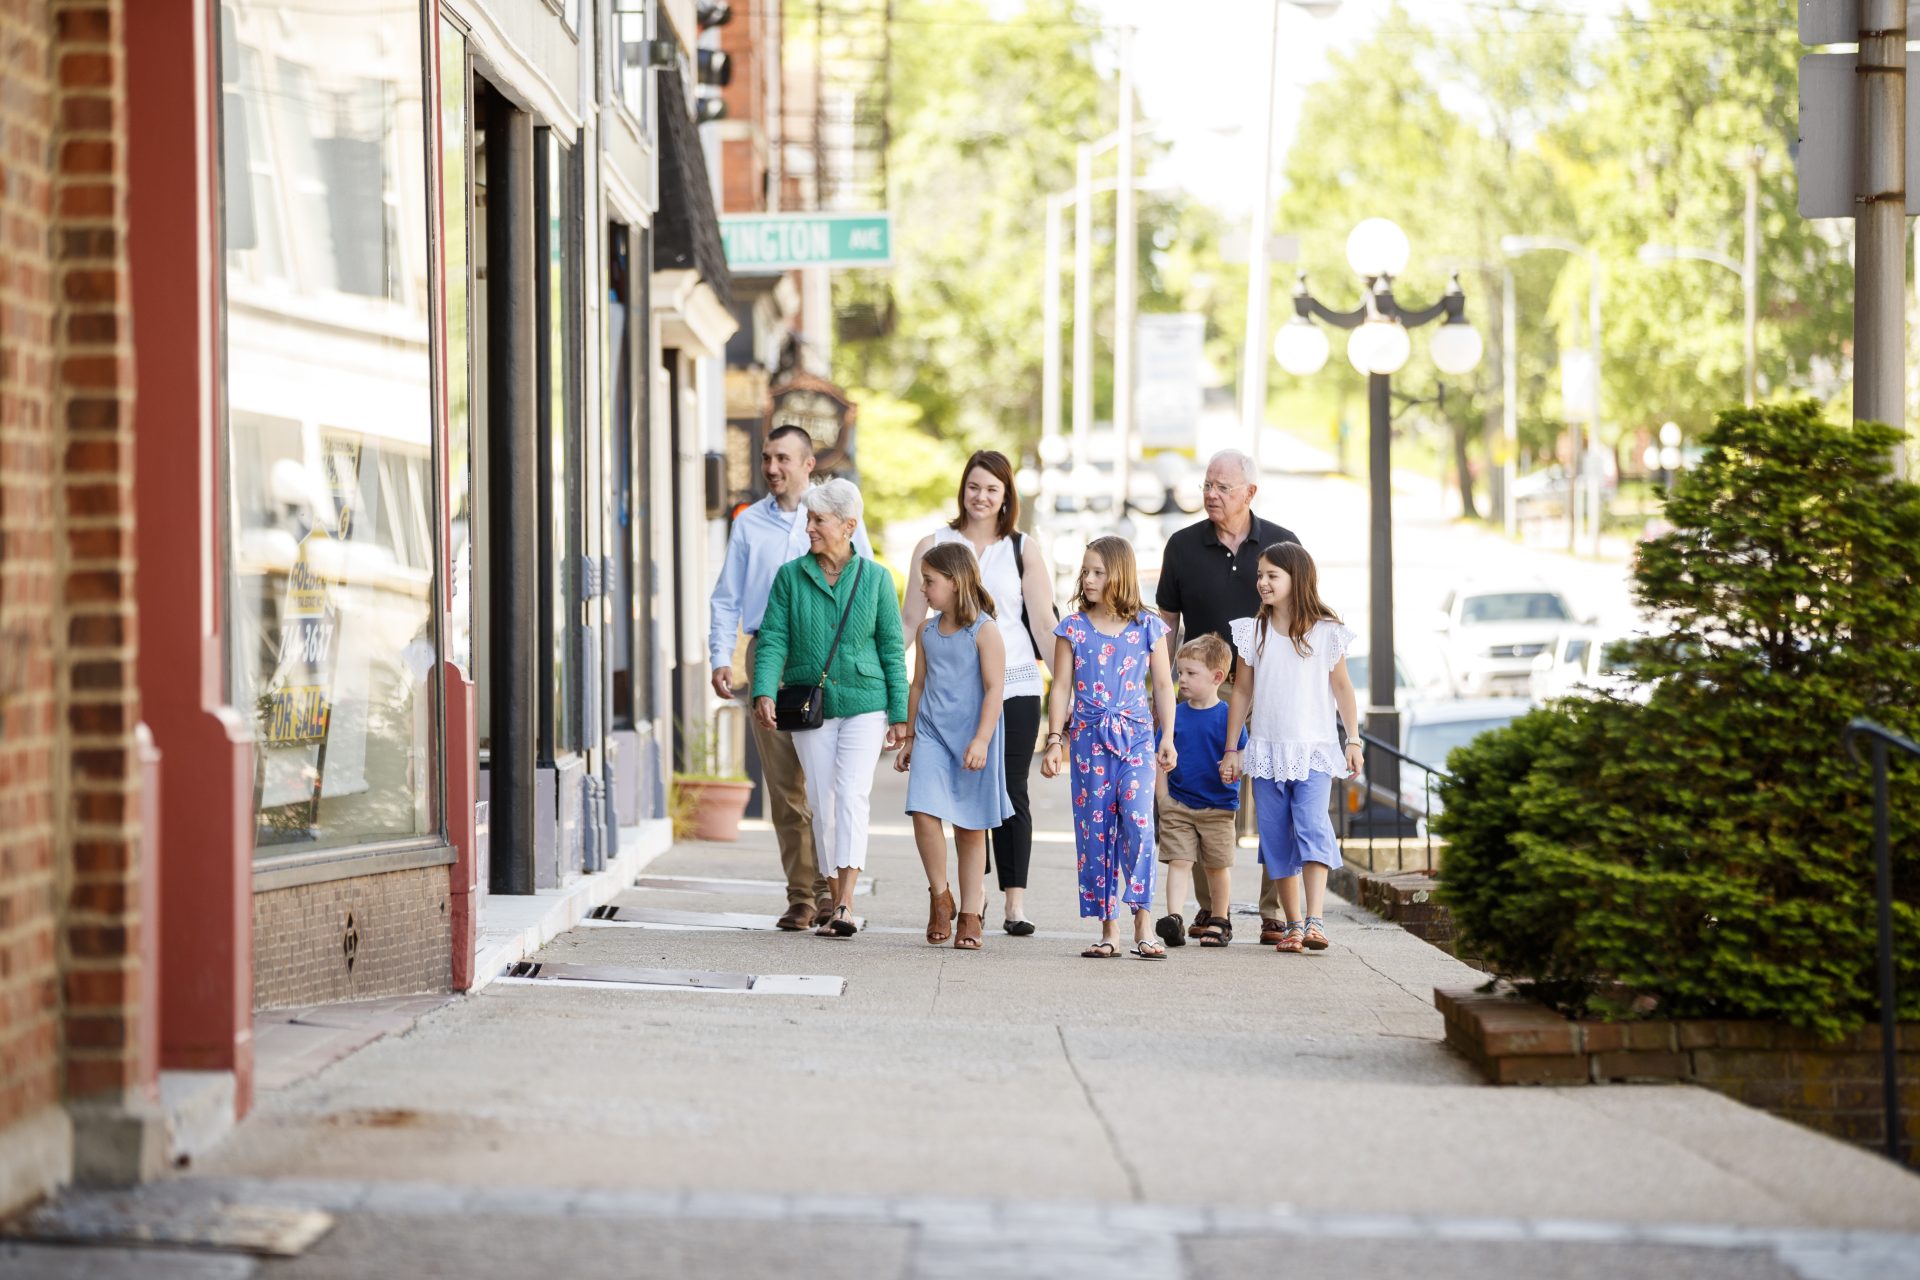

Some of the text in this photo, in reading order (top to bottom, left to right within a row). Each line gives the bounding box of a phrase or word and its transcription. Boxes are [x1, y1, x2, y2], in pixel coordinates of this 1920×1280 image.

[849, 227, 883, 251] AVE
[270, 688, 325, 738] FOR SALE
